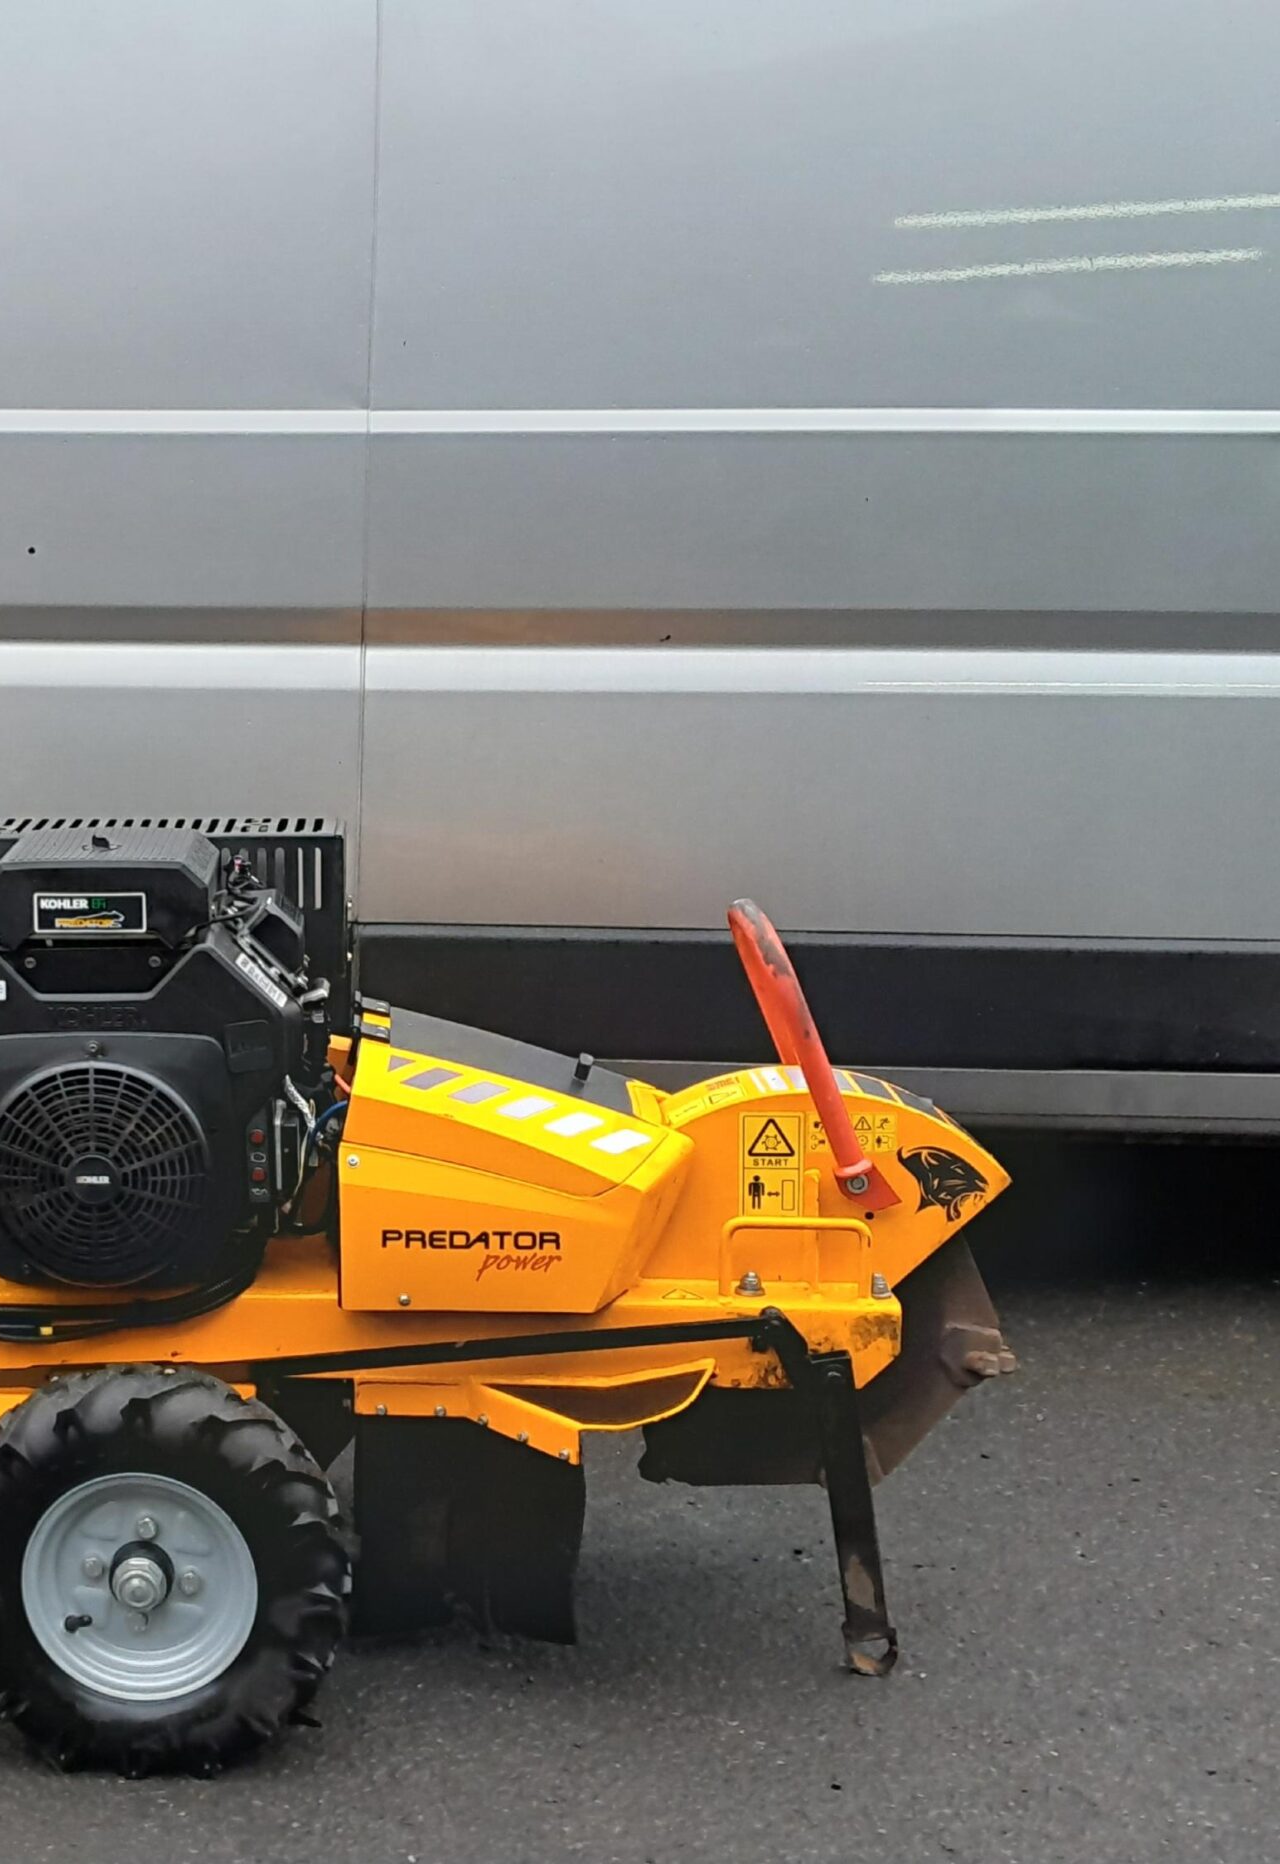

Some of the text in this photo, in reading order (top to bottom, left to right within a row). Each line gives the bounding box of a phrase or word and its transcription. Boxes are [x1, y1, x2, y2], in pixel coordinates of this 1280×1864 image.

[40, 898, 89, 909] KOHLER
[752, 1157, 790, 1168] START
[381, 1229, 561, 1251] PREDATOR
[475, 1252, 562, 1282] power
